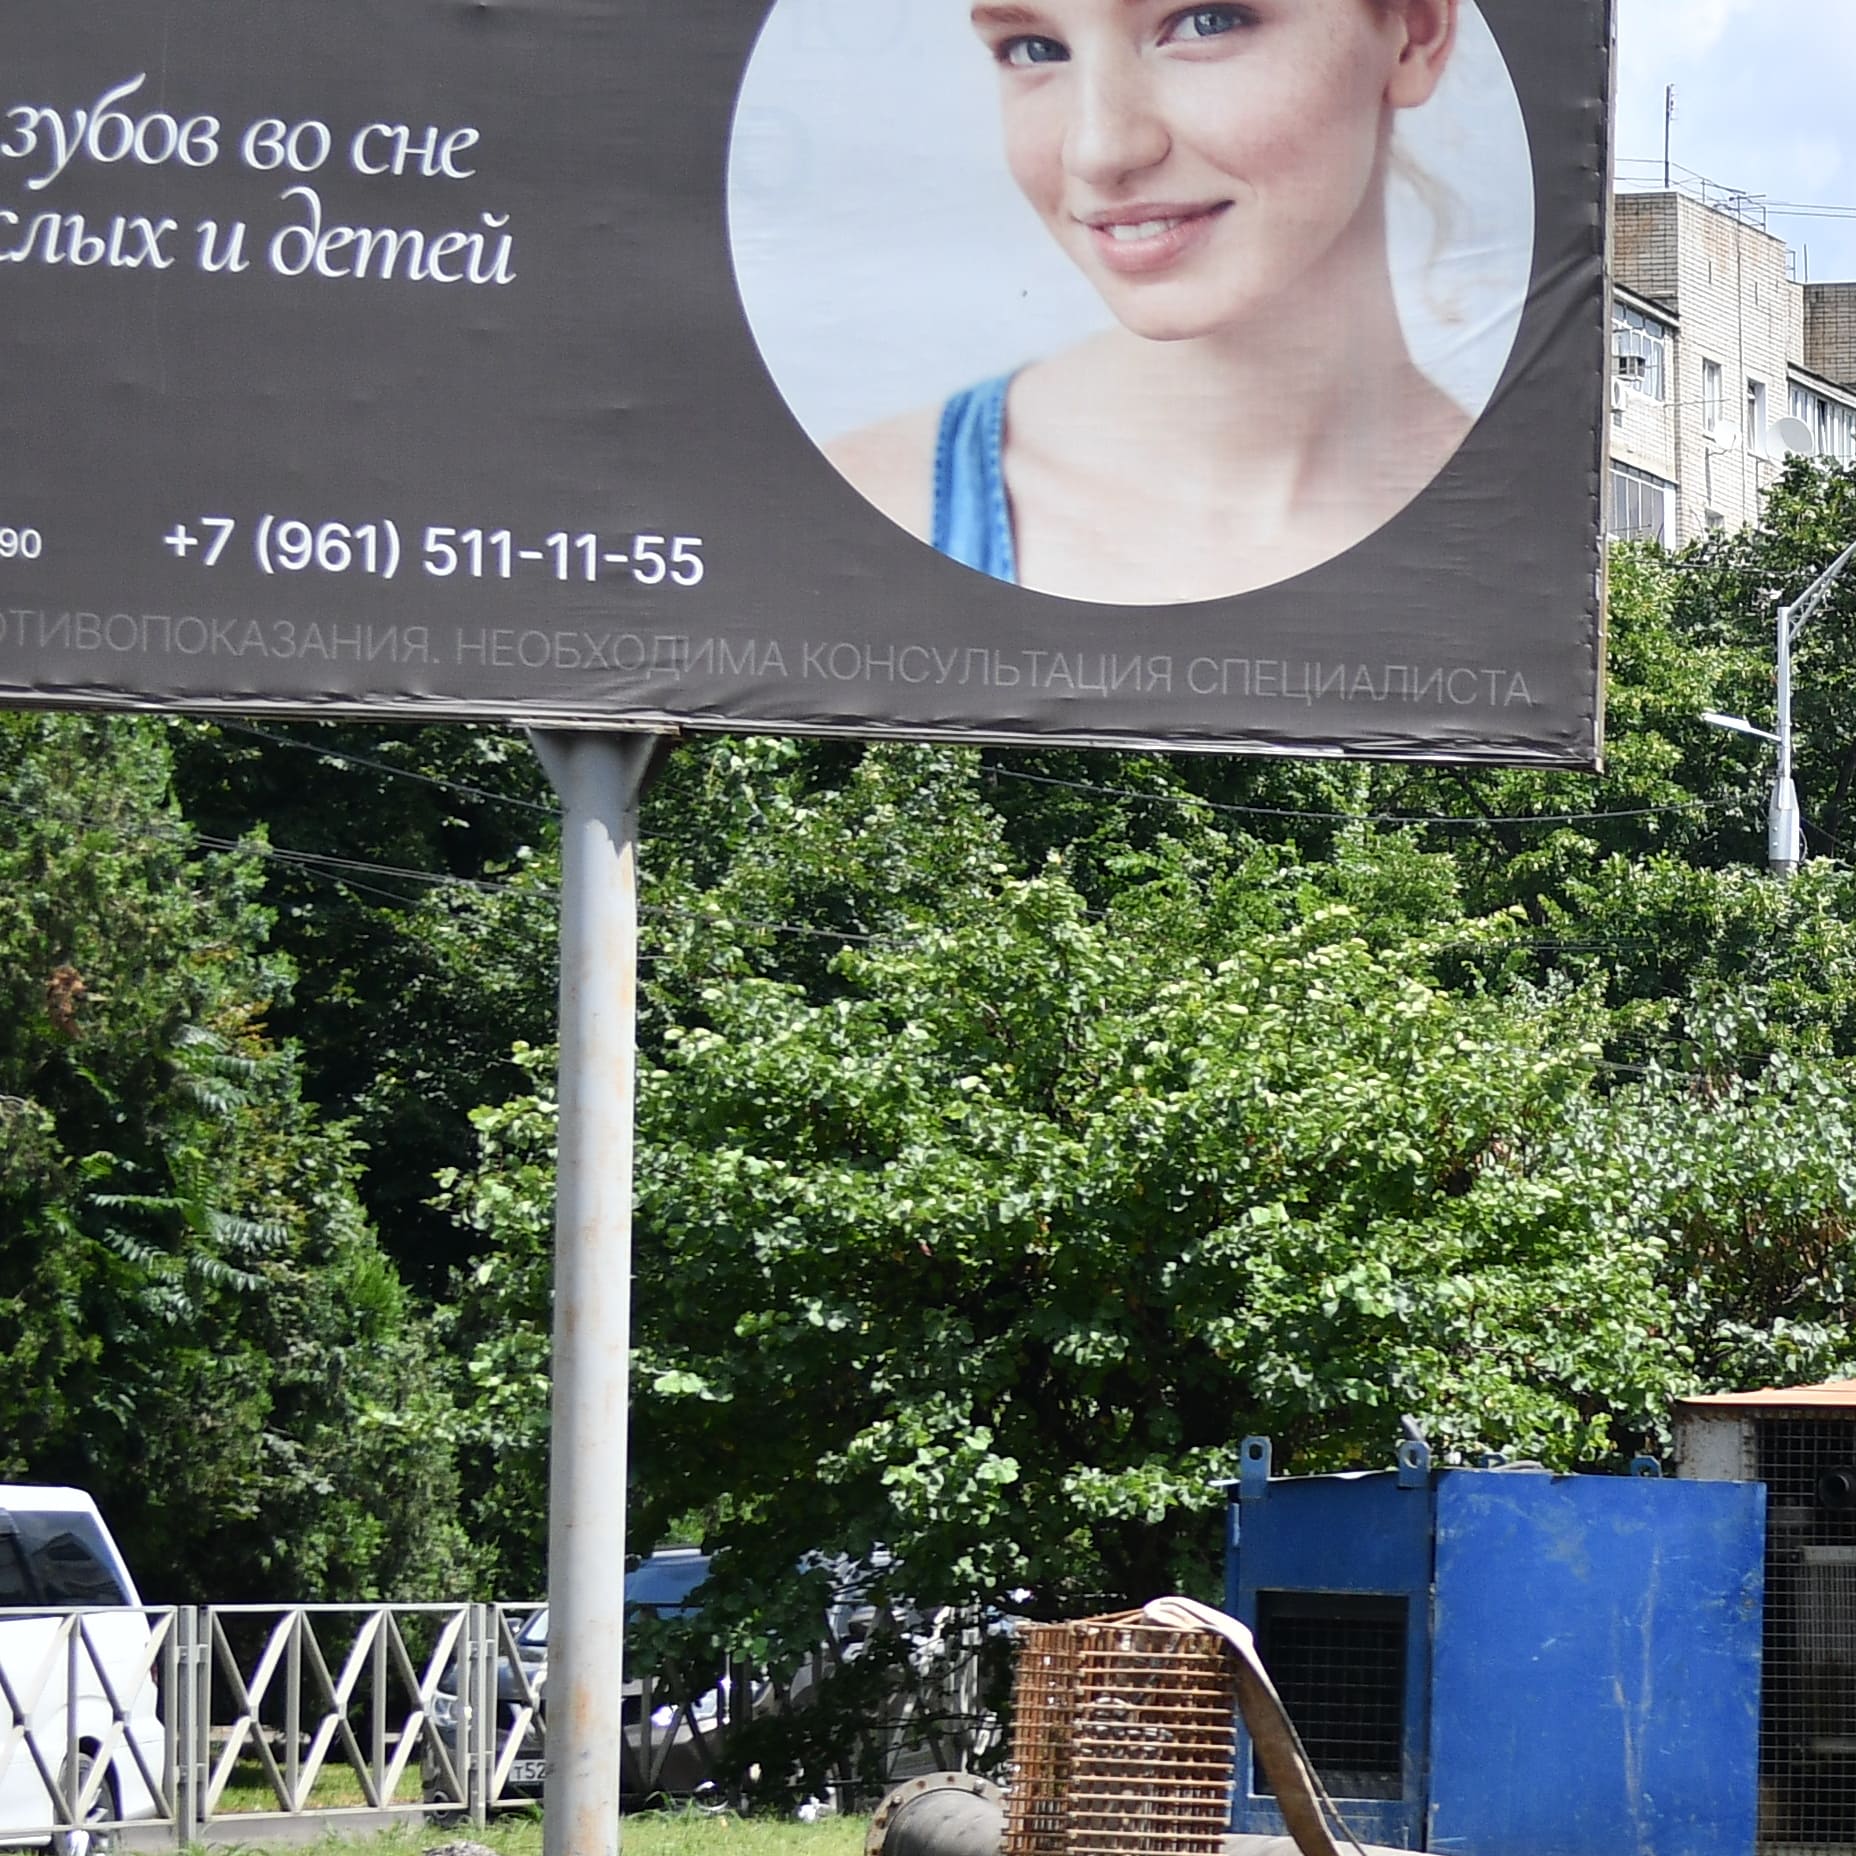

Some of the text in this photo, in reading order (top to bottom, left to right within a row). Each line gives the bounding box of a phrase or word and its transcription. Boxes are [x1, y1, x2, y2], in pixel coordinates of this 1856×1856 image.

[1, 73, 480, 190] зубов во сне
[199, 219, 250, 272] и
[271, 186, 517, 285] детей
[165, 515, 705, 586] +7 (961) 511-11-55
[457, 627, 788, 683] НЕОБХОДИМА
[804, 642, 1172, 700] КОНСУЛЬТАЦИЯ
[1187, 656, 1533, 709] СПЕЦИАЛИСТА
